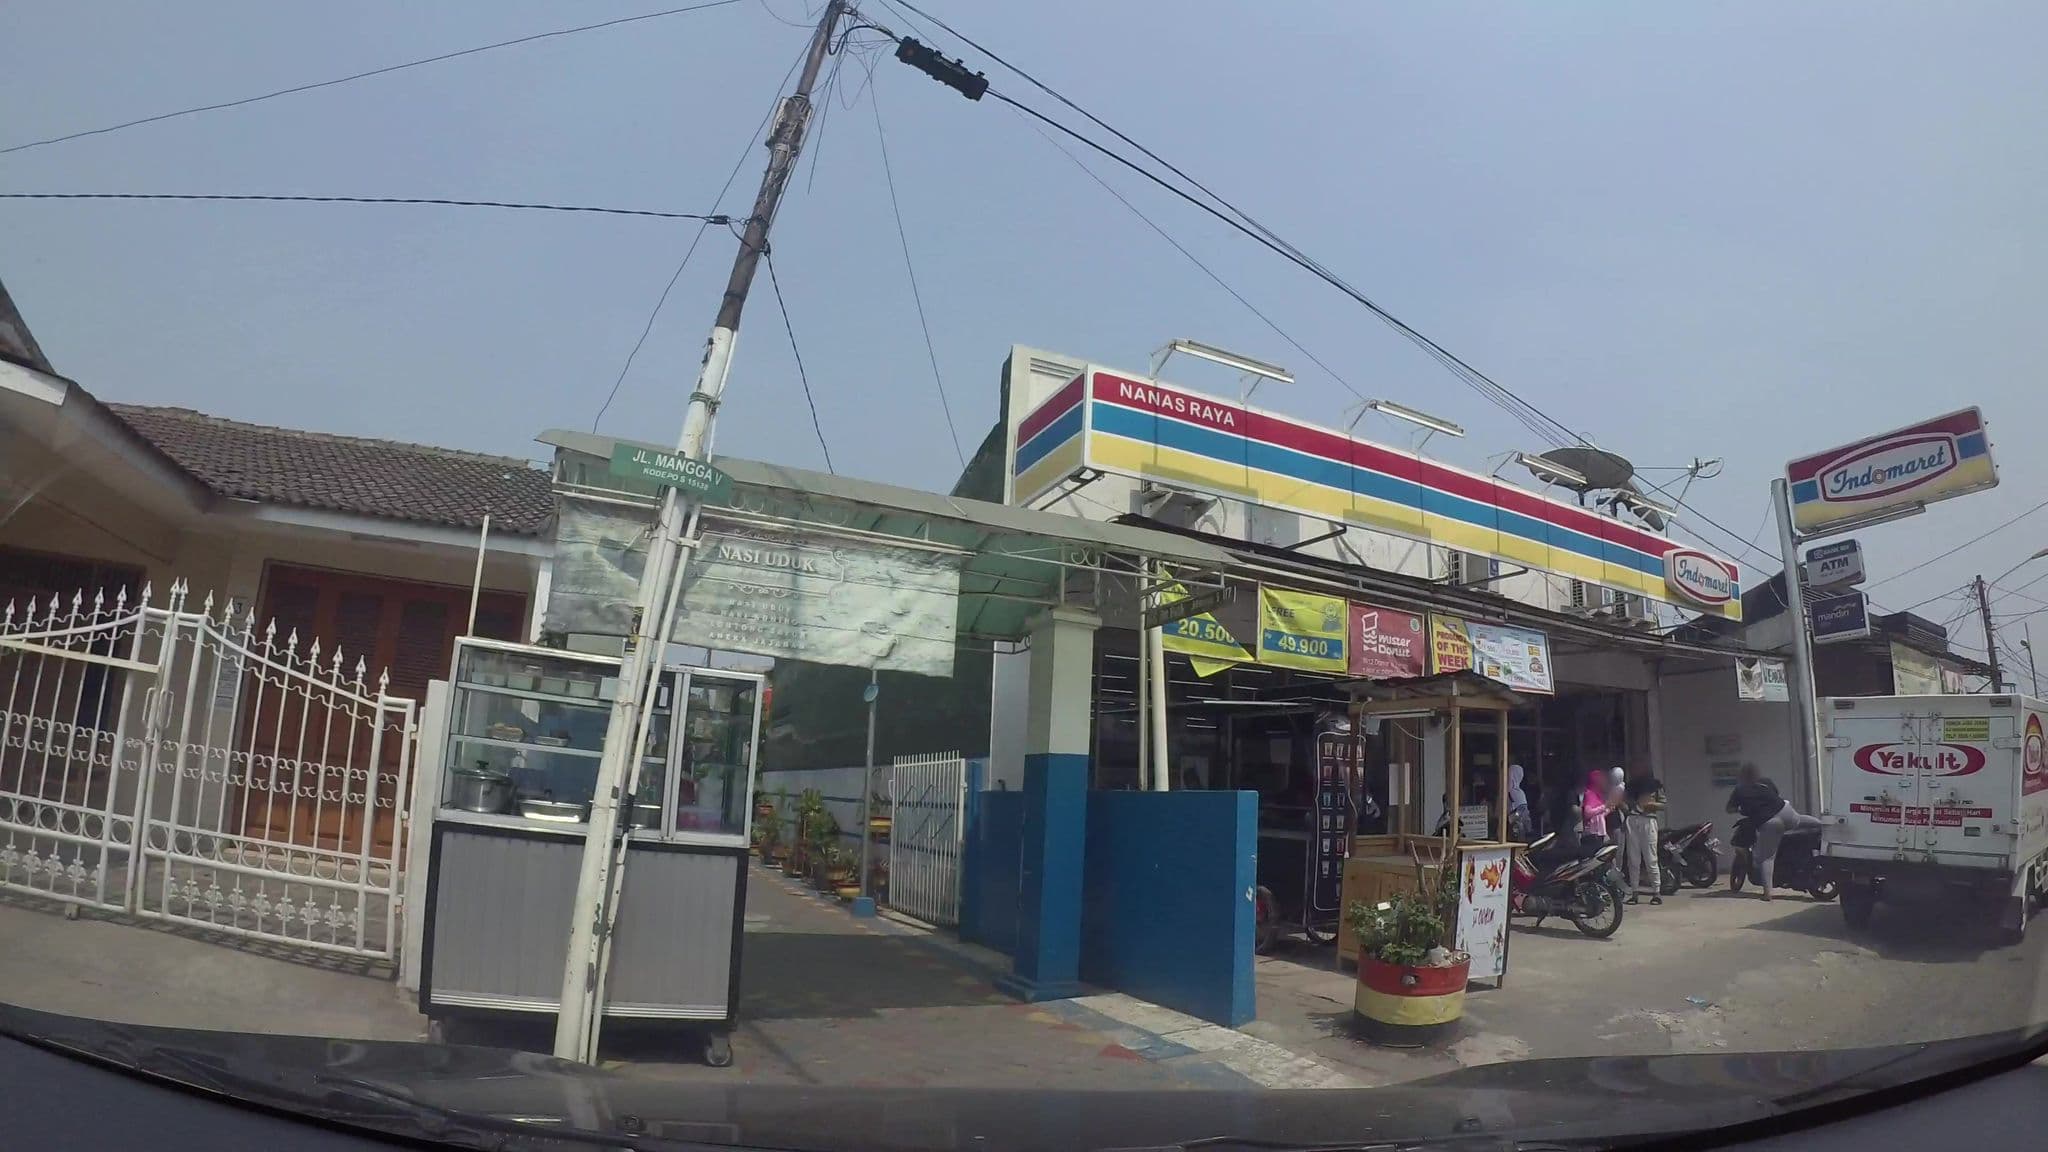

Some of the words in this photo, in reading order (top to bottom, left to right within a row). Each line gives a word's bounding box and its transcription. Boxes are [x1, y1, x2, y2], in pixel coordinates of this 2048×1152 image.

[1120, 382, 1185, 412] NANAS
[1190, 404, 1235, 426] RAYA
[632, 450, 651, 465] JL.
[655, 454, 712, 482] MANGGA
[715, 471, 723, 486] V
[1830, 445, 1947, 494] Indomaret
[718, 545, 760, 564] NASI
[765, 551, 816, 572] UDUK
[1820, 556, 1850, 573] ATM
[1678, 559, 1729, 594] Indomaret
[1278, 635, 1328, 656] 49.900
[1436, 641, 1449, 652] OF
[1450, 643, 1468, 656] THE
[1437, 653, 1469, 668] WEEK
[1877, 752, 1961, 770] Yakult
